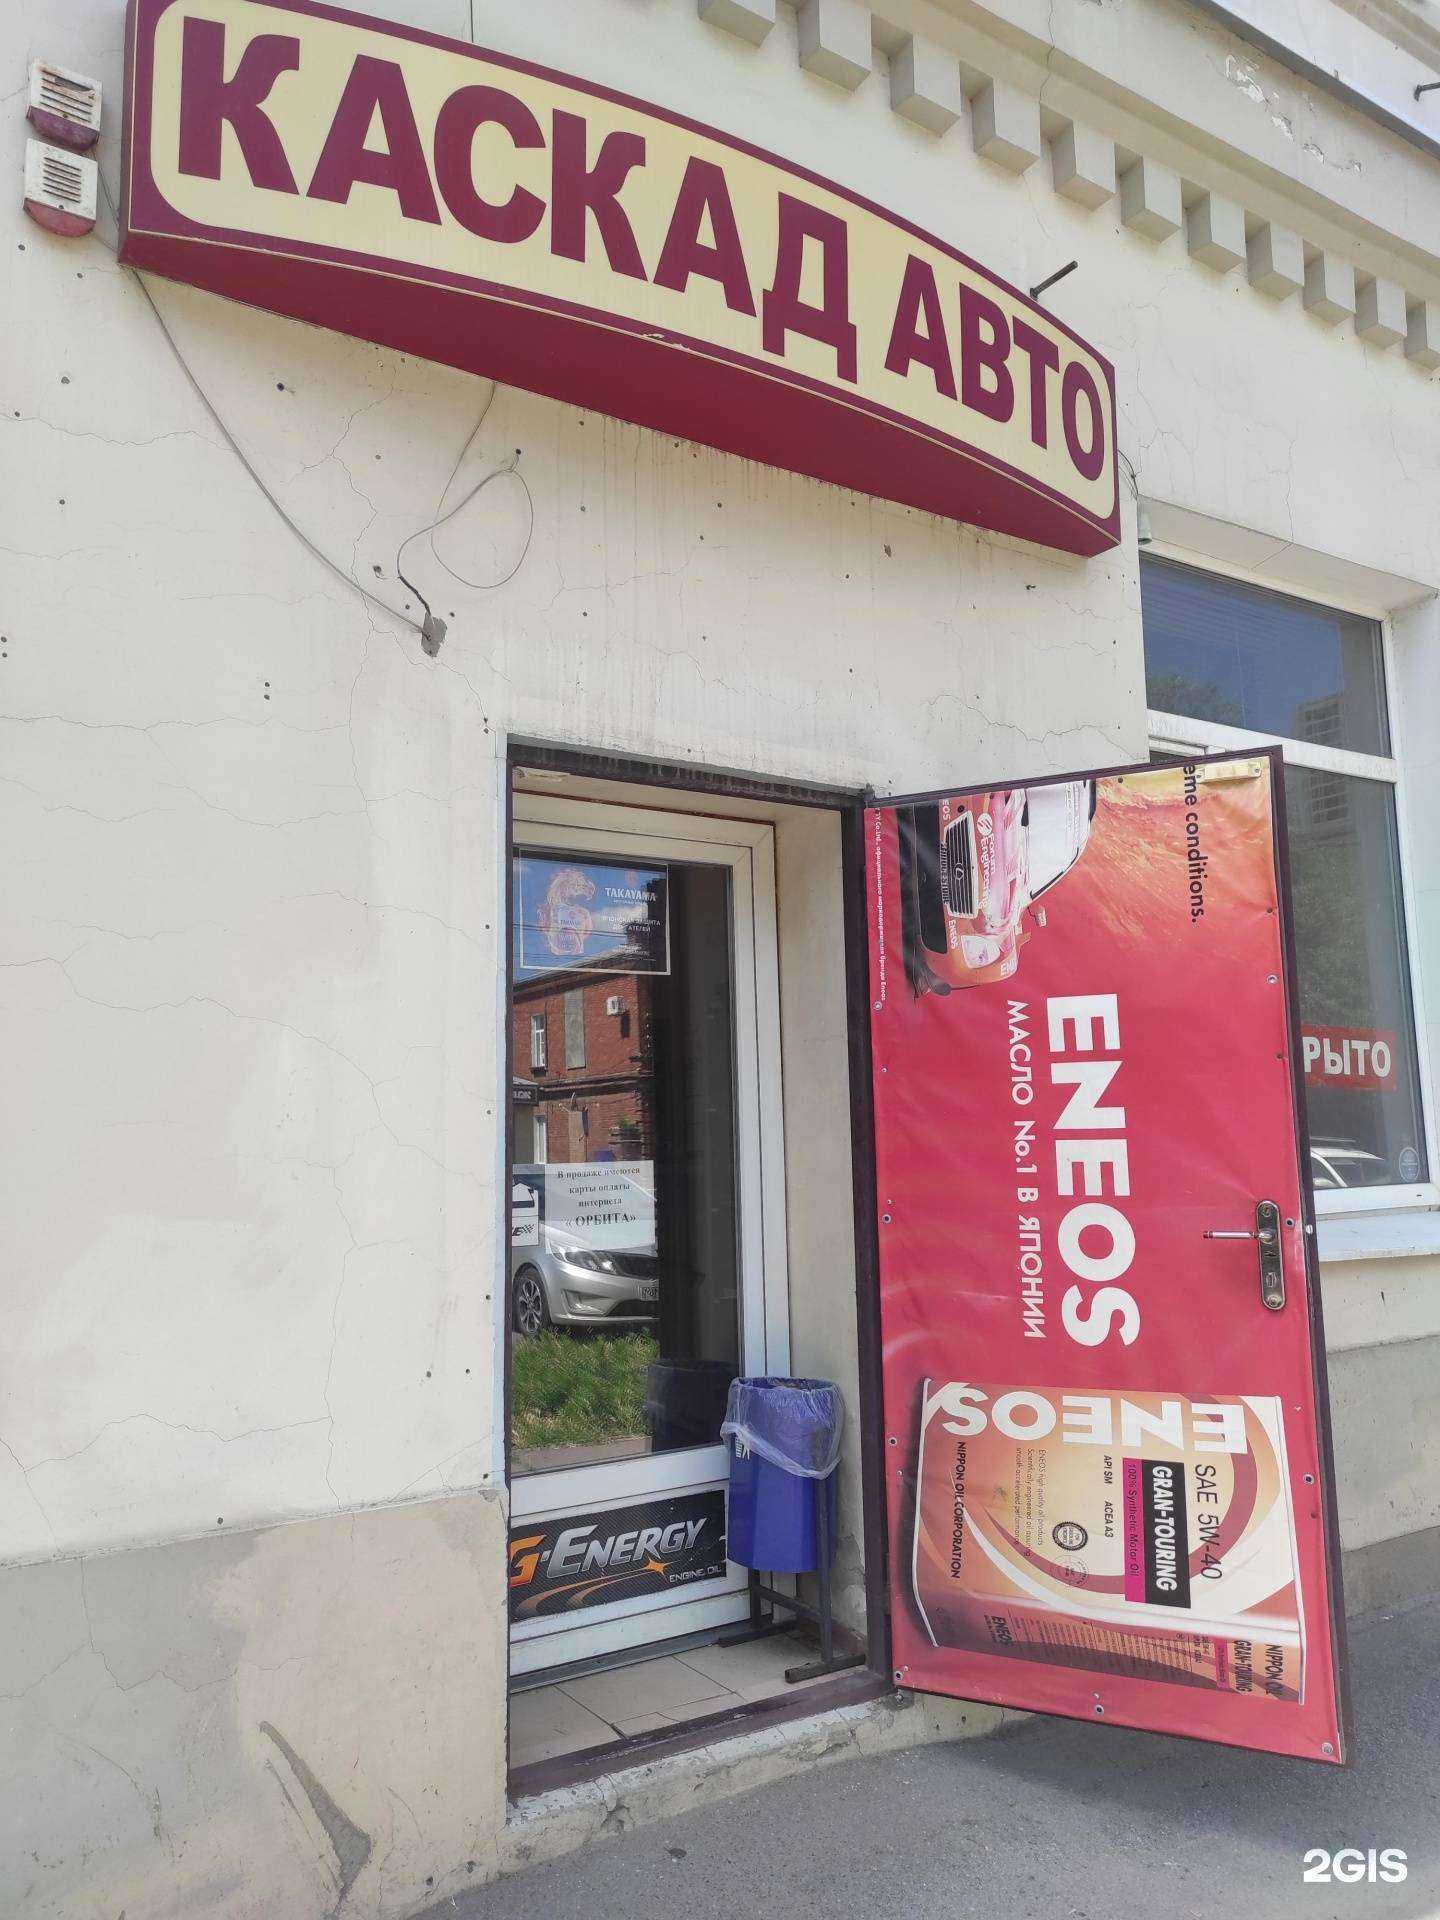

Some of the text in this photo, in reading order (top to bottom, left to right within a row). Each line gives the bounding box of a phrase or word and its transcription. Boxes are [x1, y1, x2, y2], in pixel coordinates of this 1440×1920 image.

[178, 15, 1105, 482] КАСКАД АВТО
[1185, 812, 1208, 923] conditions.
[1302, 1036, 1391, 1078] РЫТО
[566, 1169, 602, 1180] продаже
[604, 1167, 640, 1176] имеются
[1006, 999, 1048, 1339] МАСЛО No.1 В ЯПОНИИ
[1046, 993, 1141, 1347] ENEOS
[569, 1184, 630, 1195] карты оплаты
[578, 1198, 622, 1208] интернета
[941, 1385, 1248, 1454] ENEOS
[1038, 1449, 1047, 1474] ENEOS
[1103, 1454, 1113, 1485] API SM
[950, 1441, 966, 1579] NIPPON OIL CORPORATION
[1103, 1500, 1113, 1538] ACEA A3
[1126, 1489, 1138, 1531] Synthetic
[1152, 1465, 1178, 1592] GRAN-TOURING
[1194, 1463, 1223, 1580] SAE 5W-40
[1036, 1518, 1044, 1546] products
[1128, 1533, 1138, 1561] Motor
[669, 1565, 722, 1584] ENGINE OIL
[1129, 1563, 1139, 1577] Oil
[1265, 1643, 1285, 1680] NIPPON
